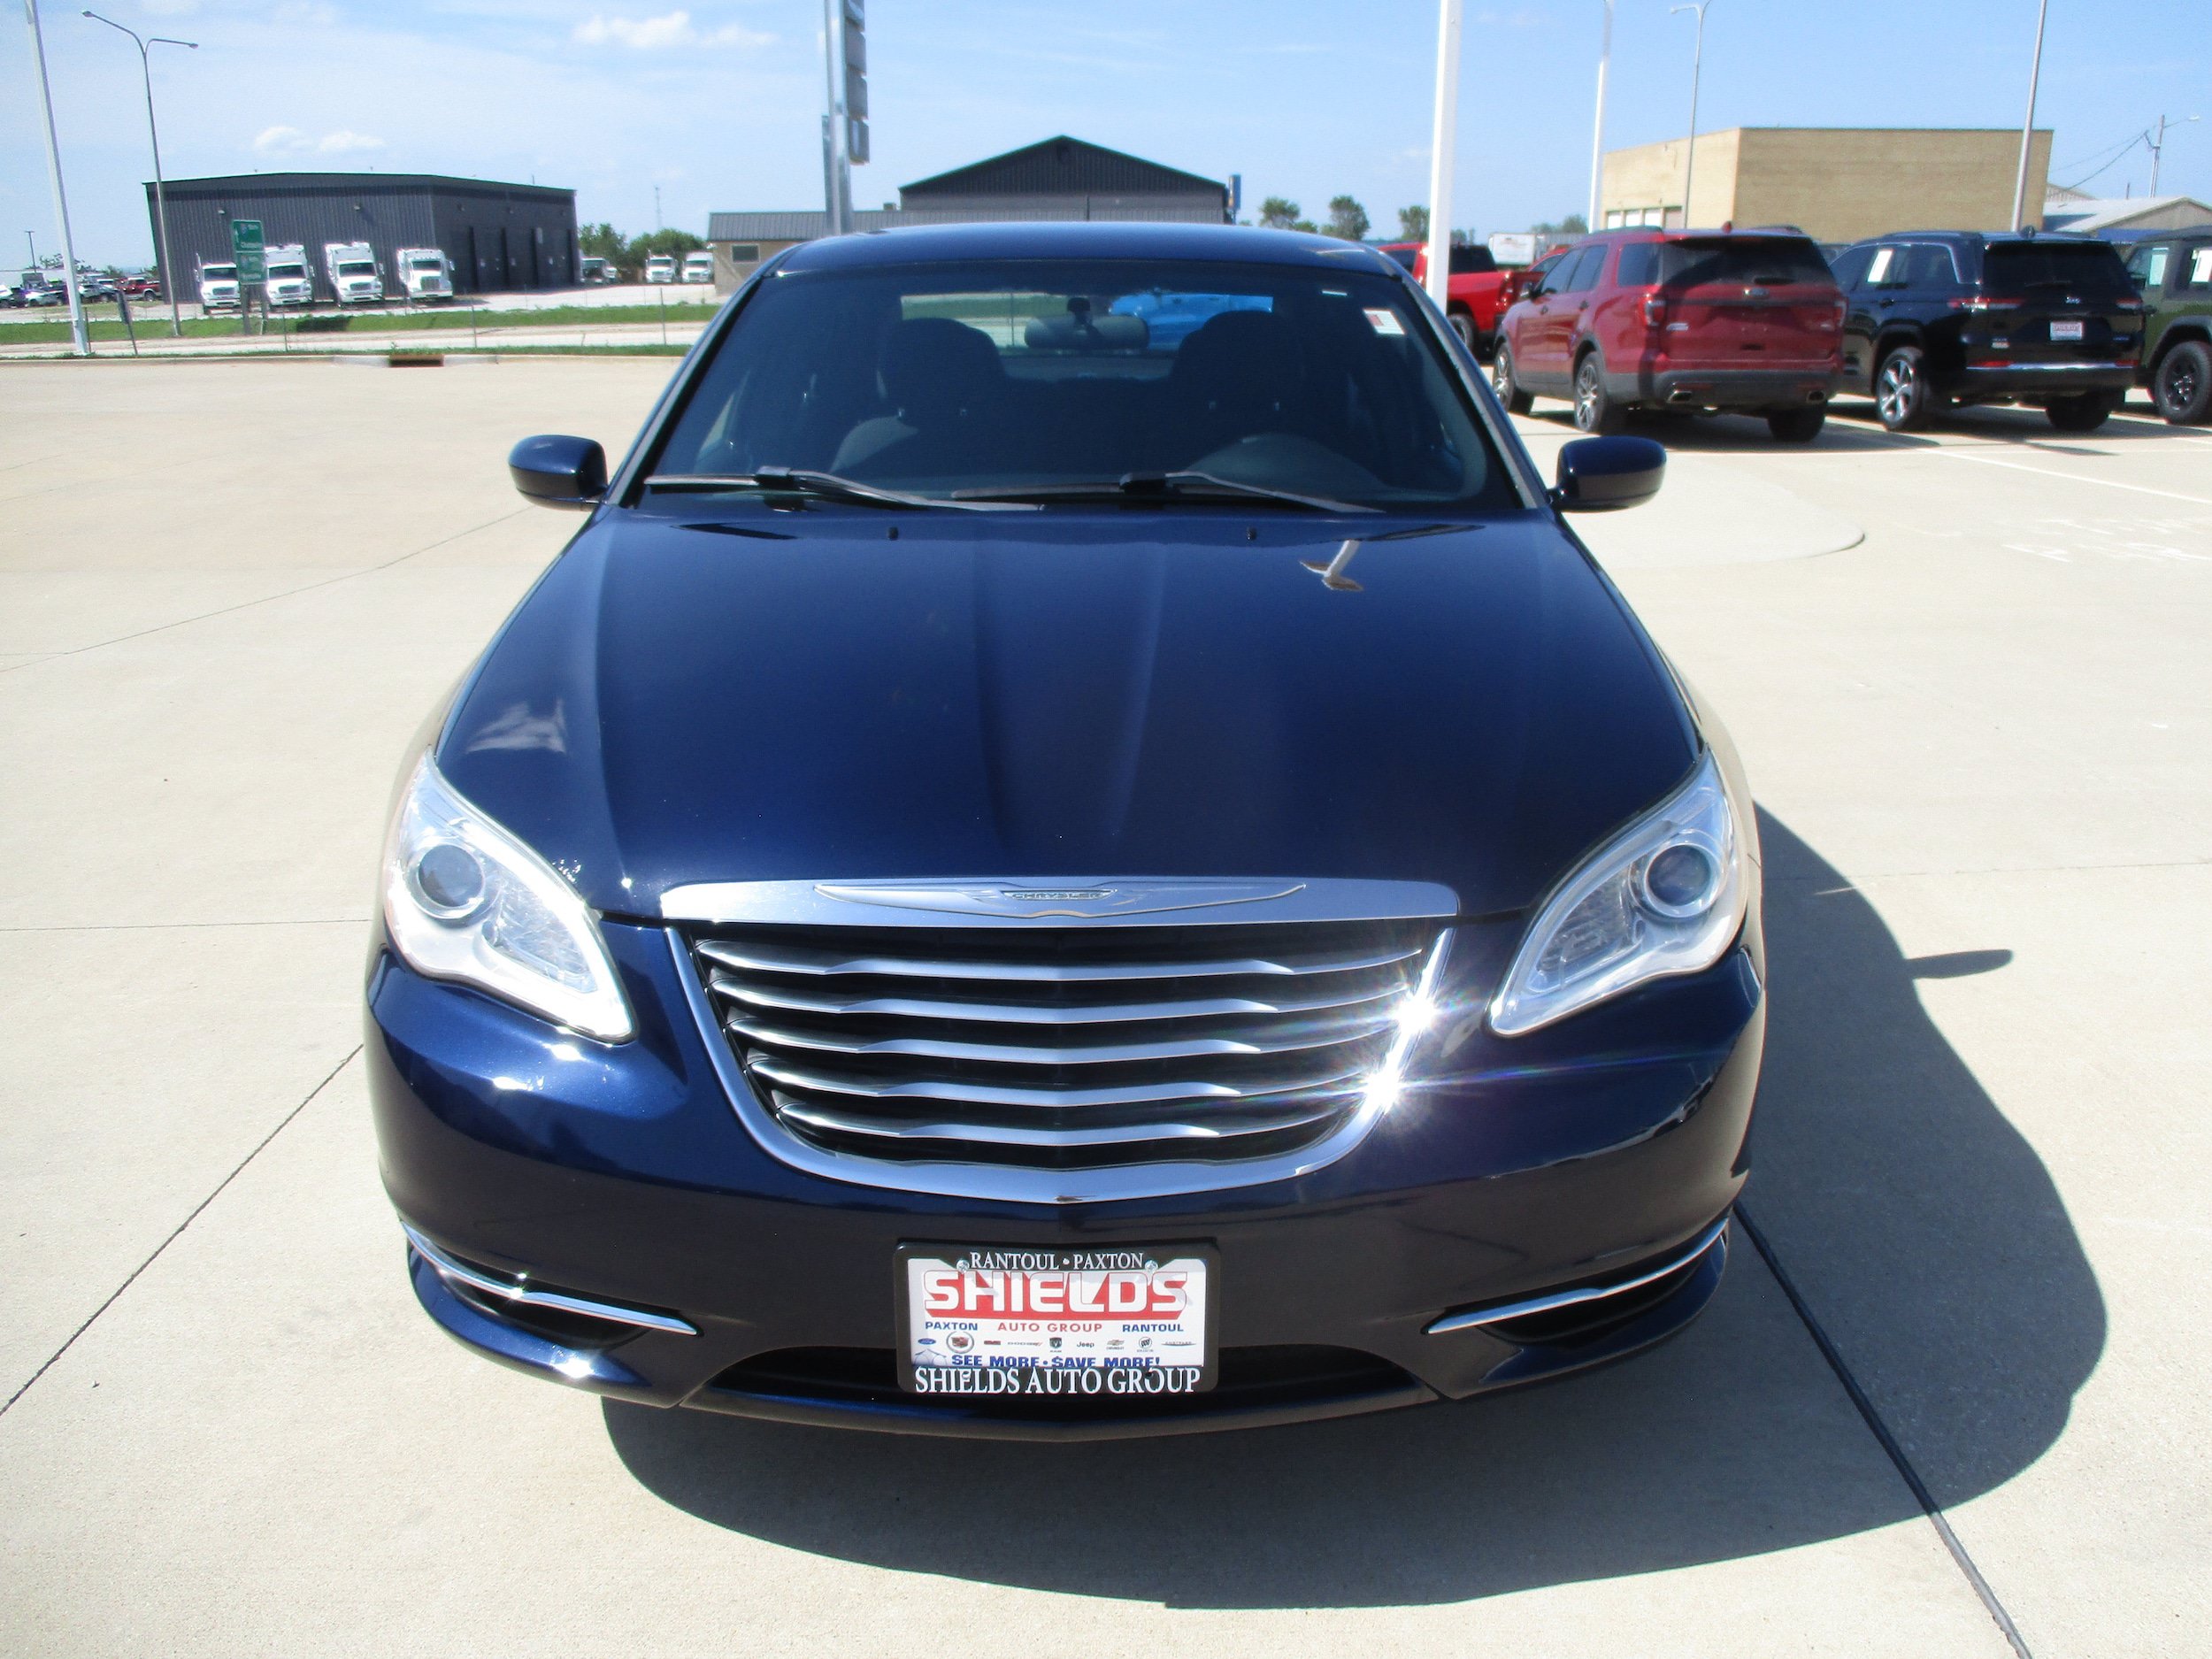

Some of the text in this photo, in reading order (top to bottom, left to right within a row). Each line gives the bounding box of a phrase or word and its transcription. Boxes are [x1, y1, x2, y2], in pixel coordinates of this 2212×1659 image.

[970, 1252, 1144, 1270] RANTOUL PAXTON
[924, 1271, 1187, 1319] SHIELDS
[925, 1321, 978, 1332] PAXTON
[998, 1323, 1102, 1333] AUTO GROUP
[1122, 1323, 1184, 1333] RANTOUL
[951, 1355, 983, 1366] SEE
[990, 1356, 1040, 1367] MORE
[1103, 1356, 1161, 1367] MORE!
[915, 1366, 1202, 1394] SHIELDS AUTO GROUP
